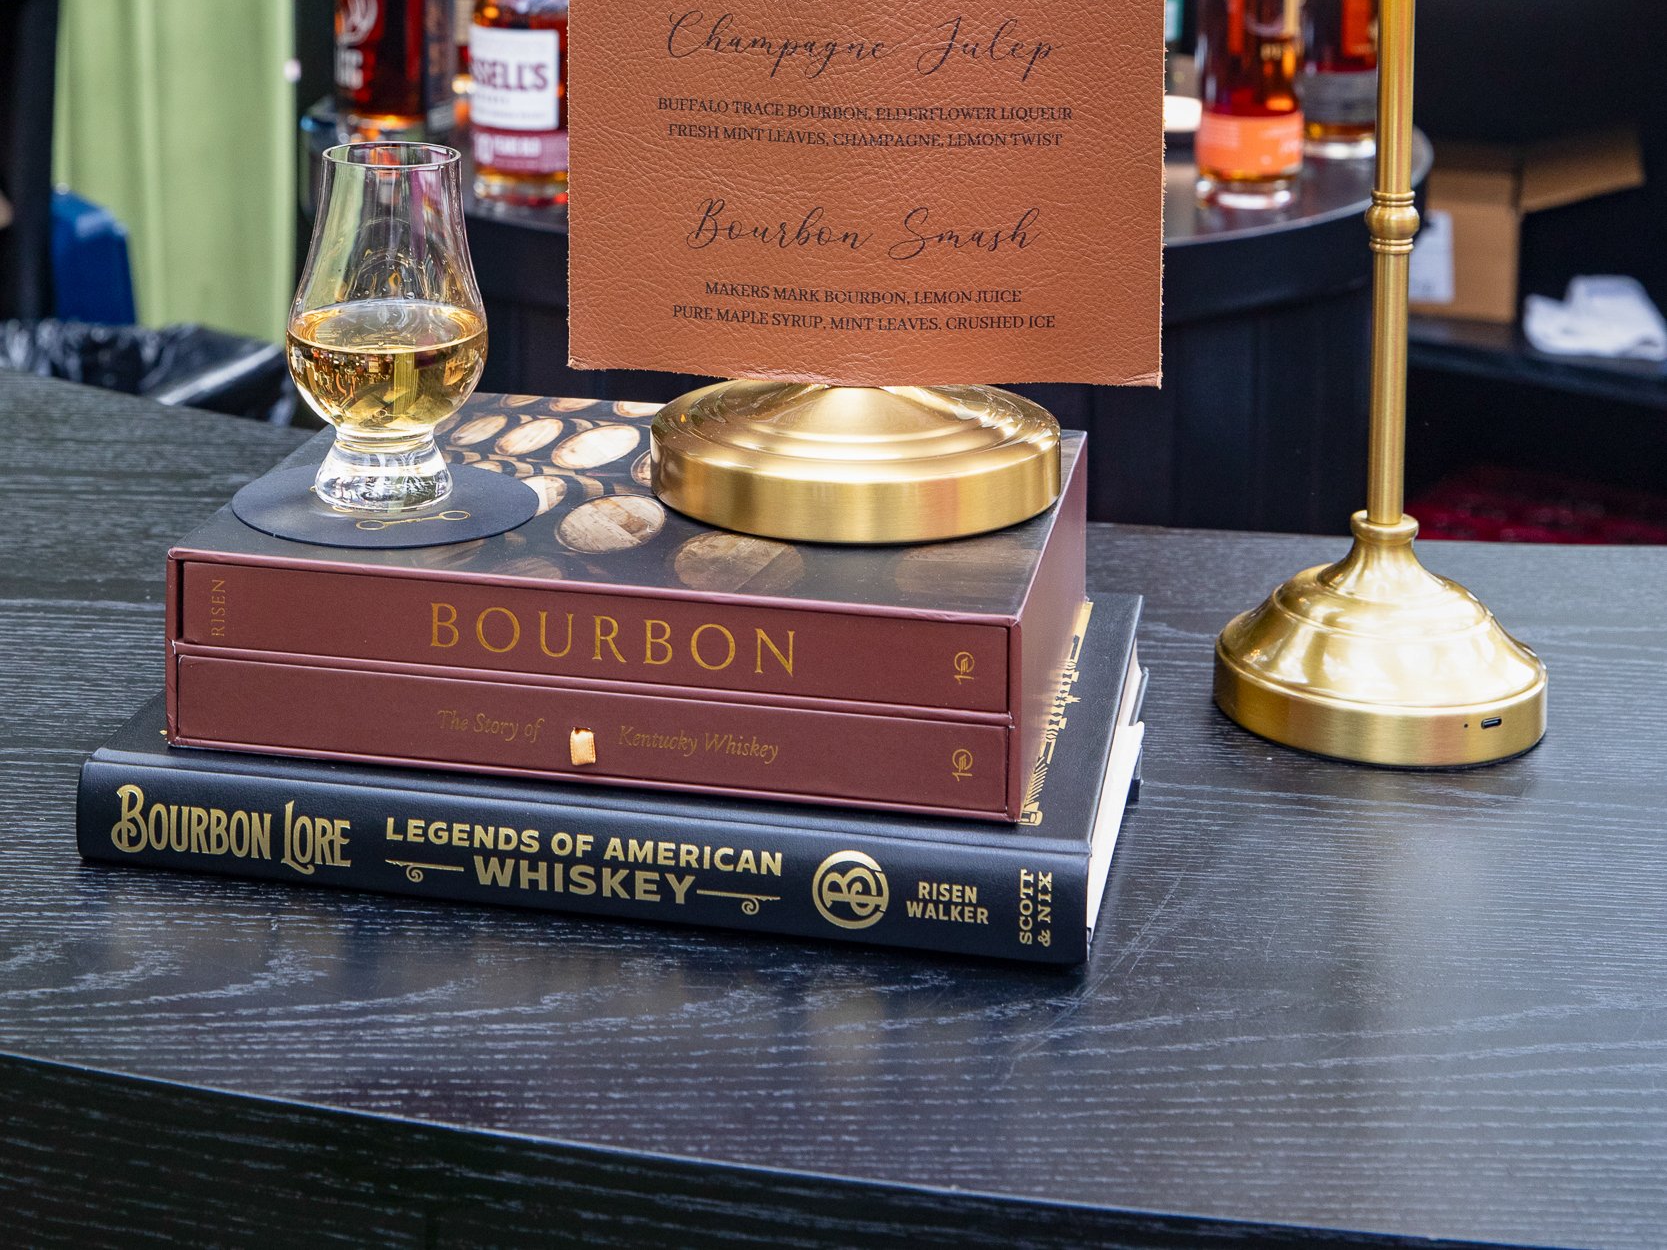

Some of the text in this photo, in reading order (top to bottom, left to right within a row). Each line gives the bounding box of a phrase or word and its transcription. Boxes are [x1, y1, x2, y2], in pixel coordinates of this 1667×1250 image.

[666, 9, 1060, 82] Champagne Julep
[657, 97, 1073, 122] BUFFALO TRACE BOURBON, ELDERFLOWER LIQUEUR
[668, 123, 1063, 149] FRESH MINT LEAVES, CHAMPAGNE, LEMON TWIST
[686, 198, 1042, 260] Bourbon Smash
[672, 305, 1055, 332] PURE MAPLE SYRUP, MINT LEAVES, CRUSHED ICE
[705, 282, 1022, 306] MAKERS MARK BOURBON, LEMON JUICE
[211, 578, 226, 638] RISEN
[430, 601, 796, 678] BOURBON
[437, 709, 780, 764] The Story of Kentucky Whiskey
[385, 817, 783, 877] LEGENDS OF AMERICAN
[473, 855, 696, 905] WHISKEY
[918, 881, 978, 904] RISEN
[1019, 868, 1034, 945] SCOTT
[906, 900, 989, 924] WALKER
[1038, 872, 1053, 946] & NIX
